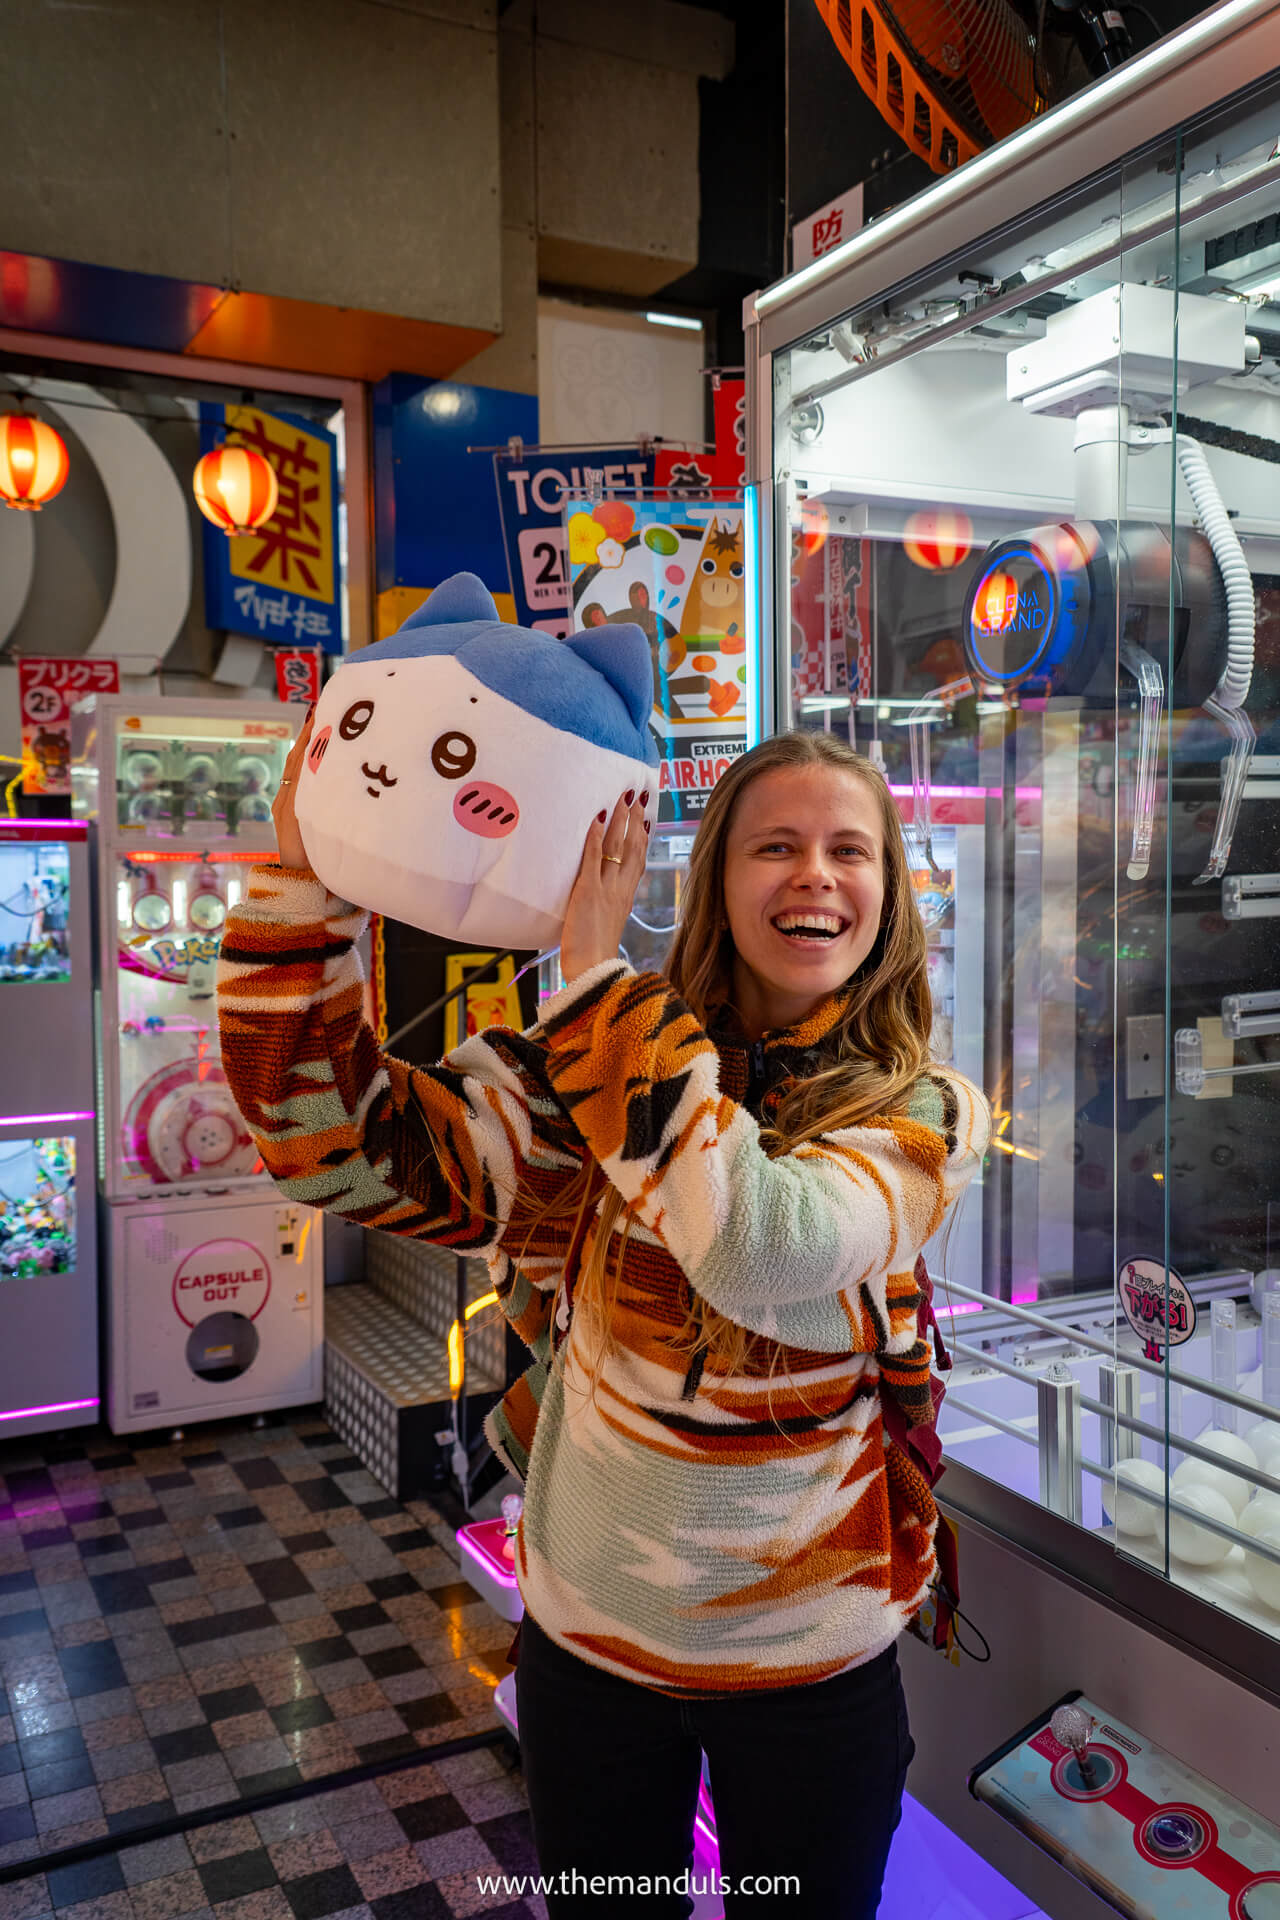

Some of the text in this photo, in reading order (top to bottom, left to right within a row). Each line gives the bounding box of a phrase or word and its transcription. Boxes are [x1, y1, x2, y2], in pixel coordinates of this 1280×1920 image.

[812, 208, 844, 257] 防
[533, 542, 569, 585] 2
[985, 590, 1039, 615] CLENA
[978, 608, 1046, 638] GRAND
[22, 662, 115, 688] プリクラ
[30, 692, 56, 713] 2F
[179, 1268, 264, 1290] CAPSULE
[203, 1286, 240, 1302] OUT
